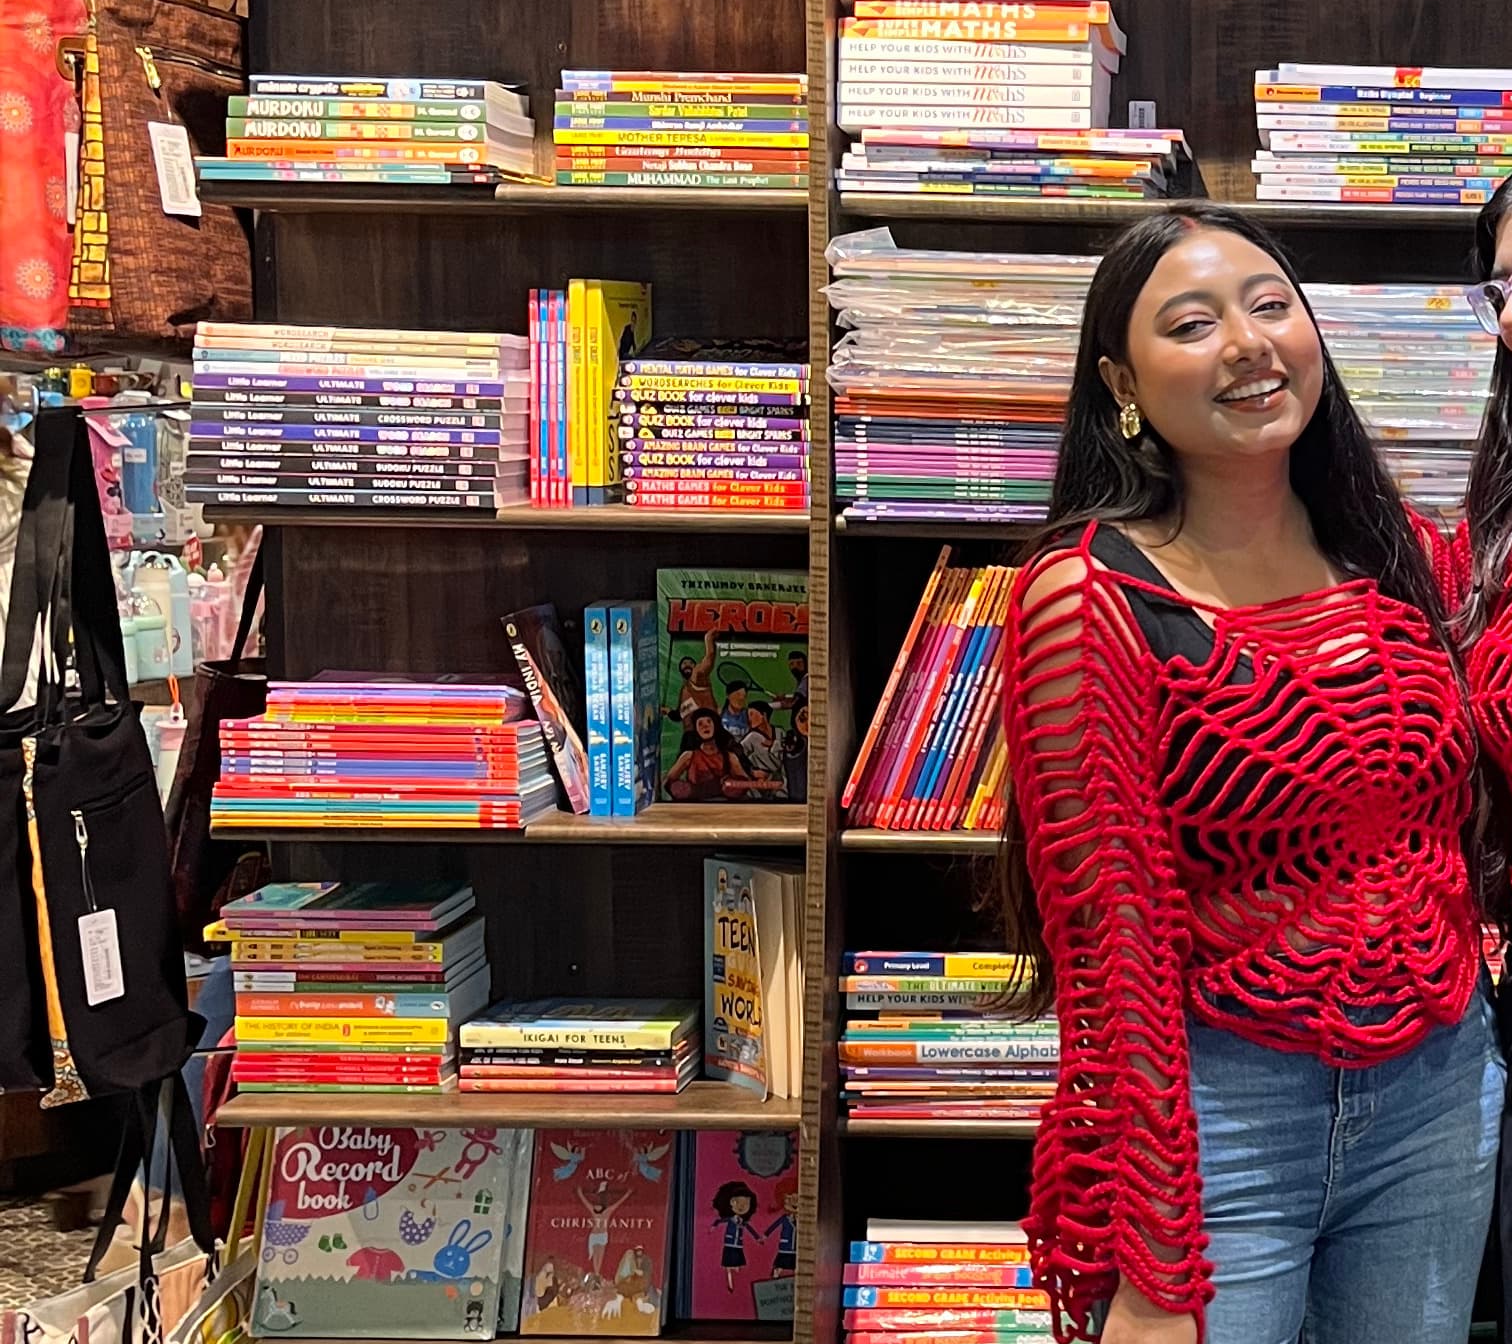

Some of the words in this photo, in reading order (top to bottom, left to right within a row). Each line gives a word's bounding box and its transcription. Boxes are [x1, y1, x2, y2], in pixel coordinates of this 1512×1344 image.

[940, 3, 1036, 20] MATHS
[921, 21, 1018, 39] MATHS
[880, 44, 911, 54] YOUR
[913, 44, 939, 54] KIDS
[247, 98, 324, 118] MURDOKU
[245, 119, 322, 139] MURDOKU
[630, 389, 656, 402] QUIZ
[657, 390, 687, 402] BOOK
[738, 392, 759, 404] kids
[512, 643, 528, 662] MY
[521, 666, 543, 707] INDIA
[857, 994, 885, 1004] HELP
[887, 995, 917, 1004] YOUR
[920, 995, 945, 1004] KIDS
[523, 1033, 559, 1043] IKIGAI
[565, 1034, 586, 1044] FOR
[593, 1034, 625, 1044] TEENS
[921, 1044, 1001, 1058] Lowercase
[319, 1127, 394, 1156] Baby
[281, 1142, 403, 1182] Record
[586, 1168, 615, 1180] ABC
[297, 1180, 353, 1209] book
[550, 1217, 654, 1230] CHRISTIANITY
[895, 1247, 937, 1259] SECOND
[979, 1249, 1022, 1262] Activity
[887, 1290, 931, 1303] SECOND
